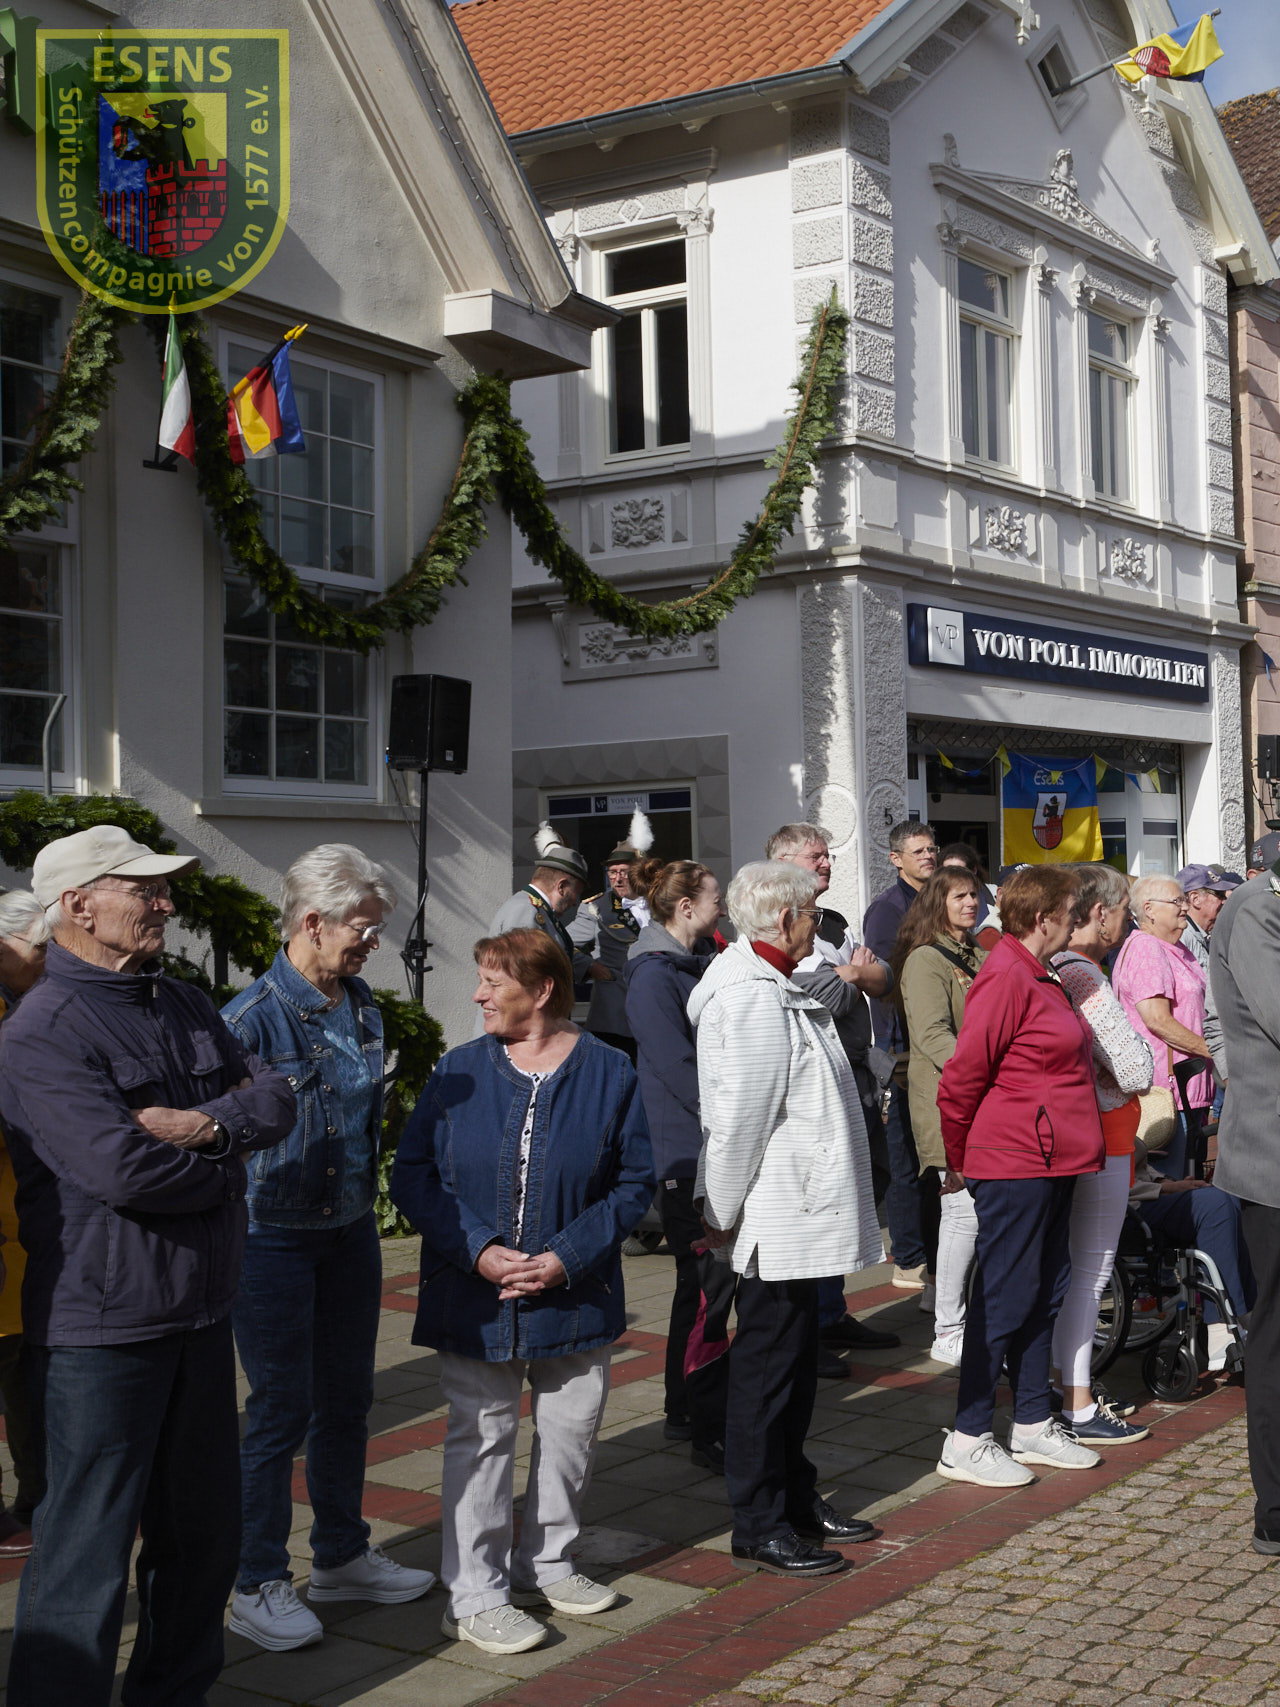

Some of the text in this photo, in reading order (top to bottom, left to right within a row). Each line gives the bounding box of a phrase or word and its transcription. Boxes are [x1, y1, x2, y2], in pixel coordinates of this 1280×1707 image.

[972, 628, 1206, 688] VON POLL IMMOBILIEN
[884, 807, 893, 825] 5
